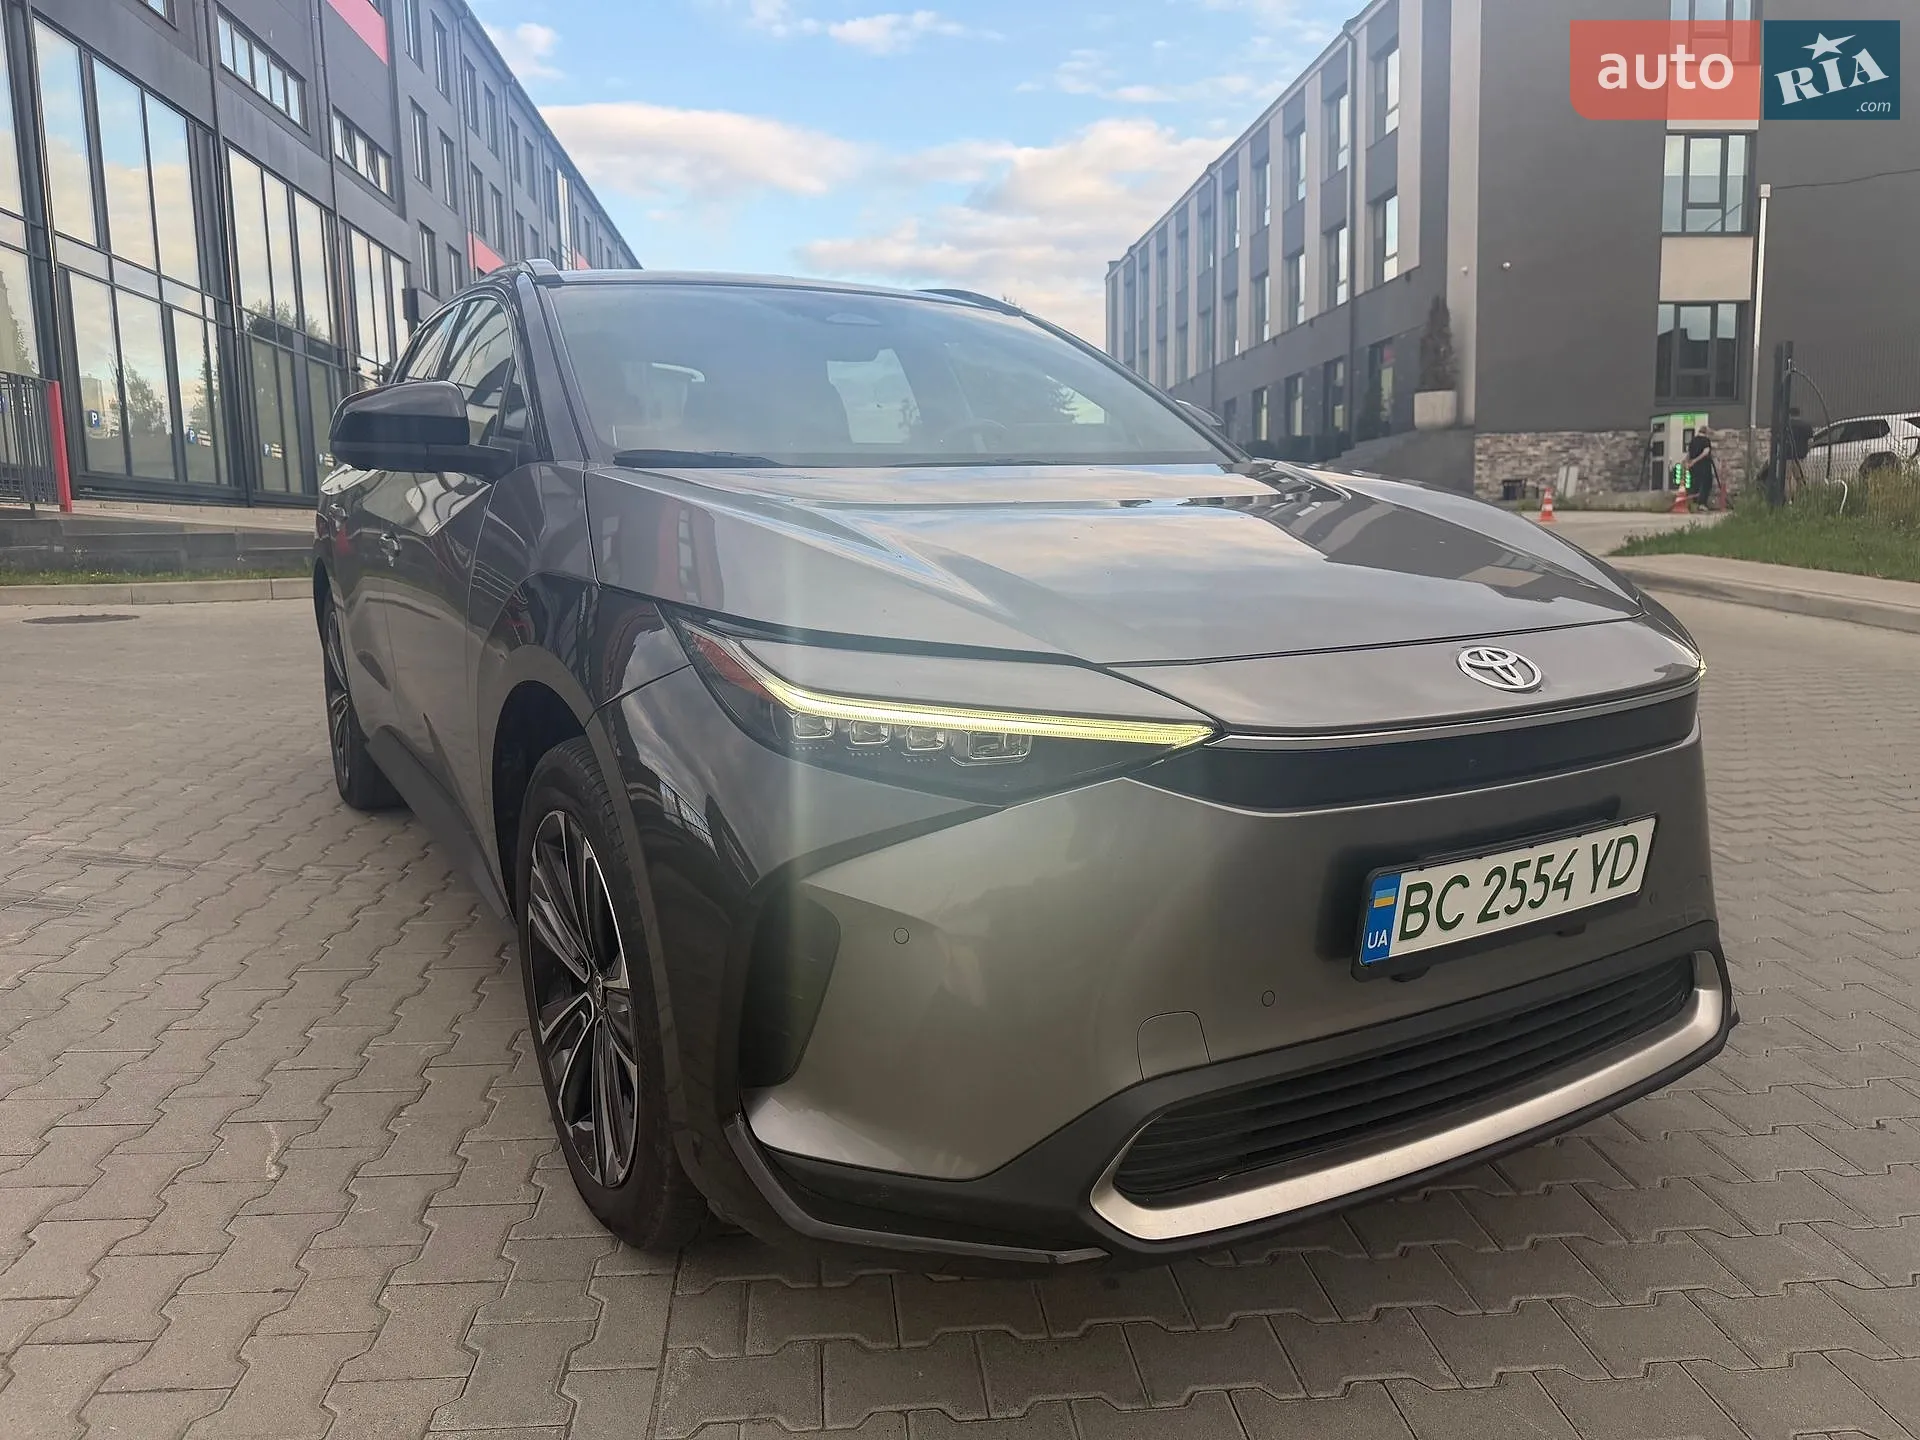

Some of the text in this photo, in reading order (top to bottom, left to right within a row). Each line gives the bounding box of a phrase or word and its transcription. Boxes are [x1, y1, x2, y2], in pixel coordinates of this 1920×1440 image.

[1398, 834, 1640, 941] BC 2554 YD
[1367, 929, 1388, 949] UA
